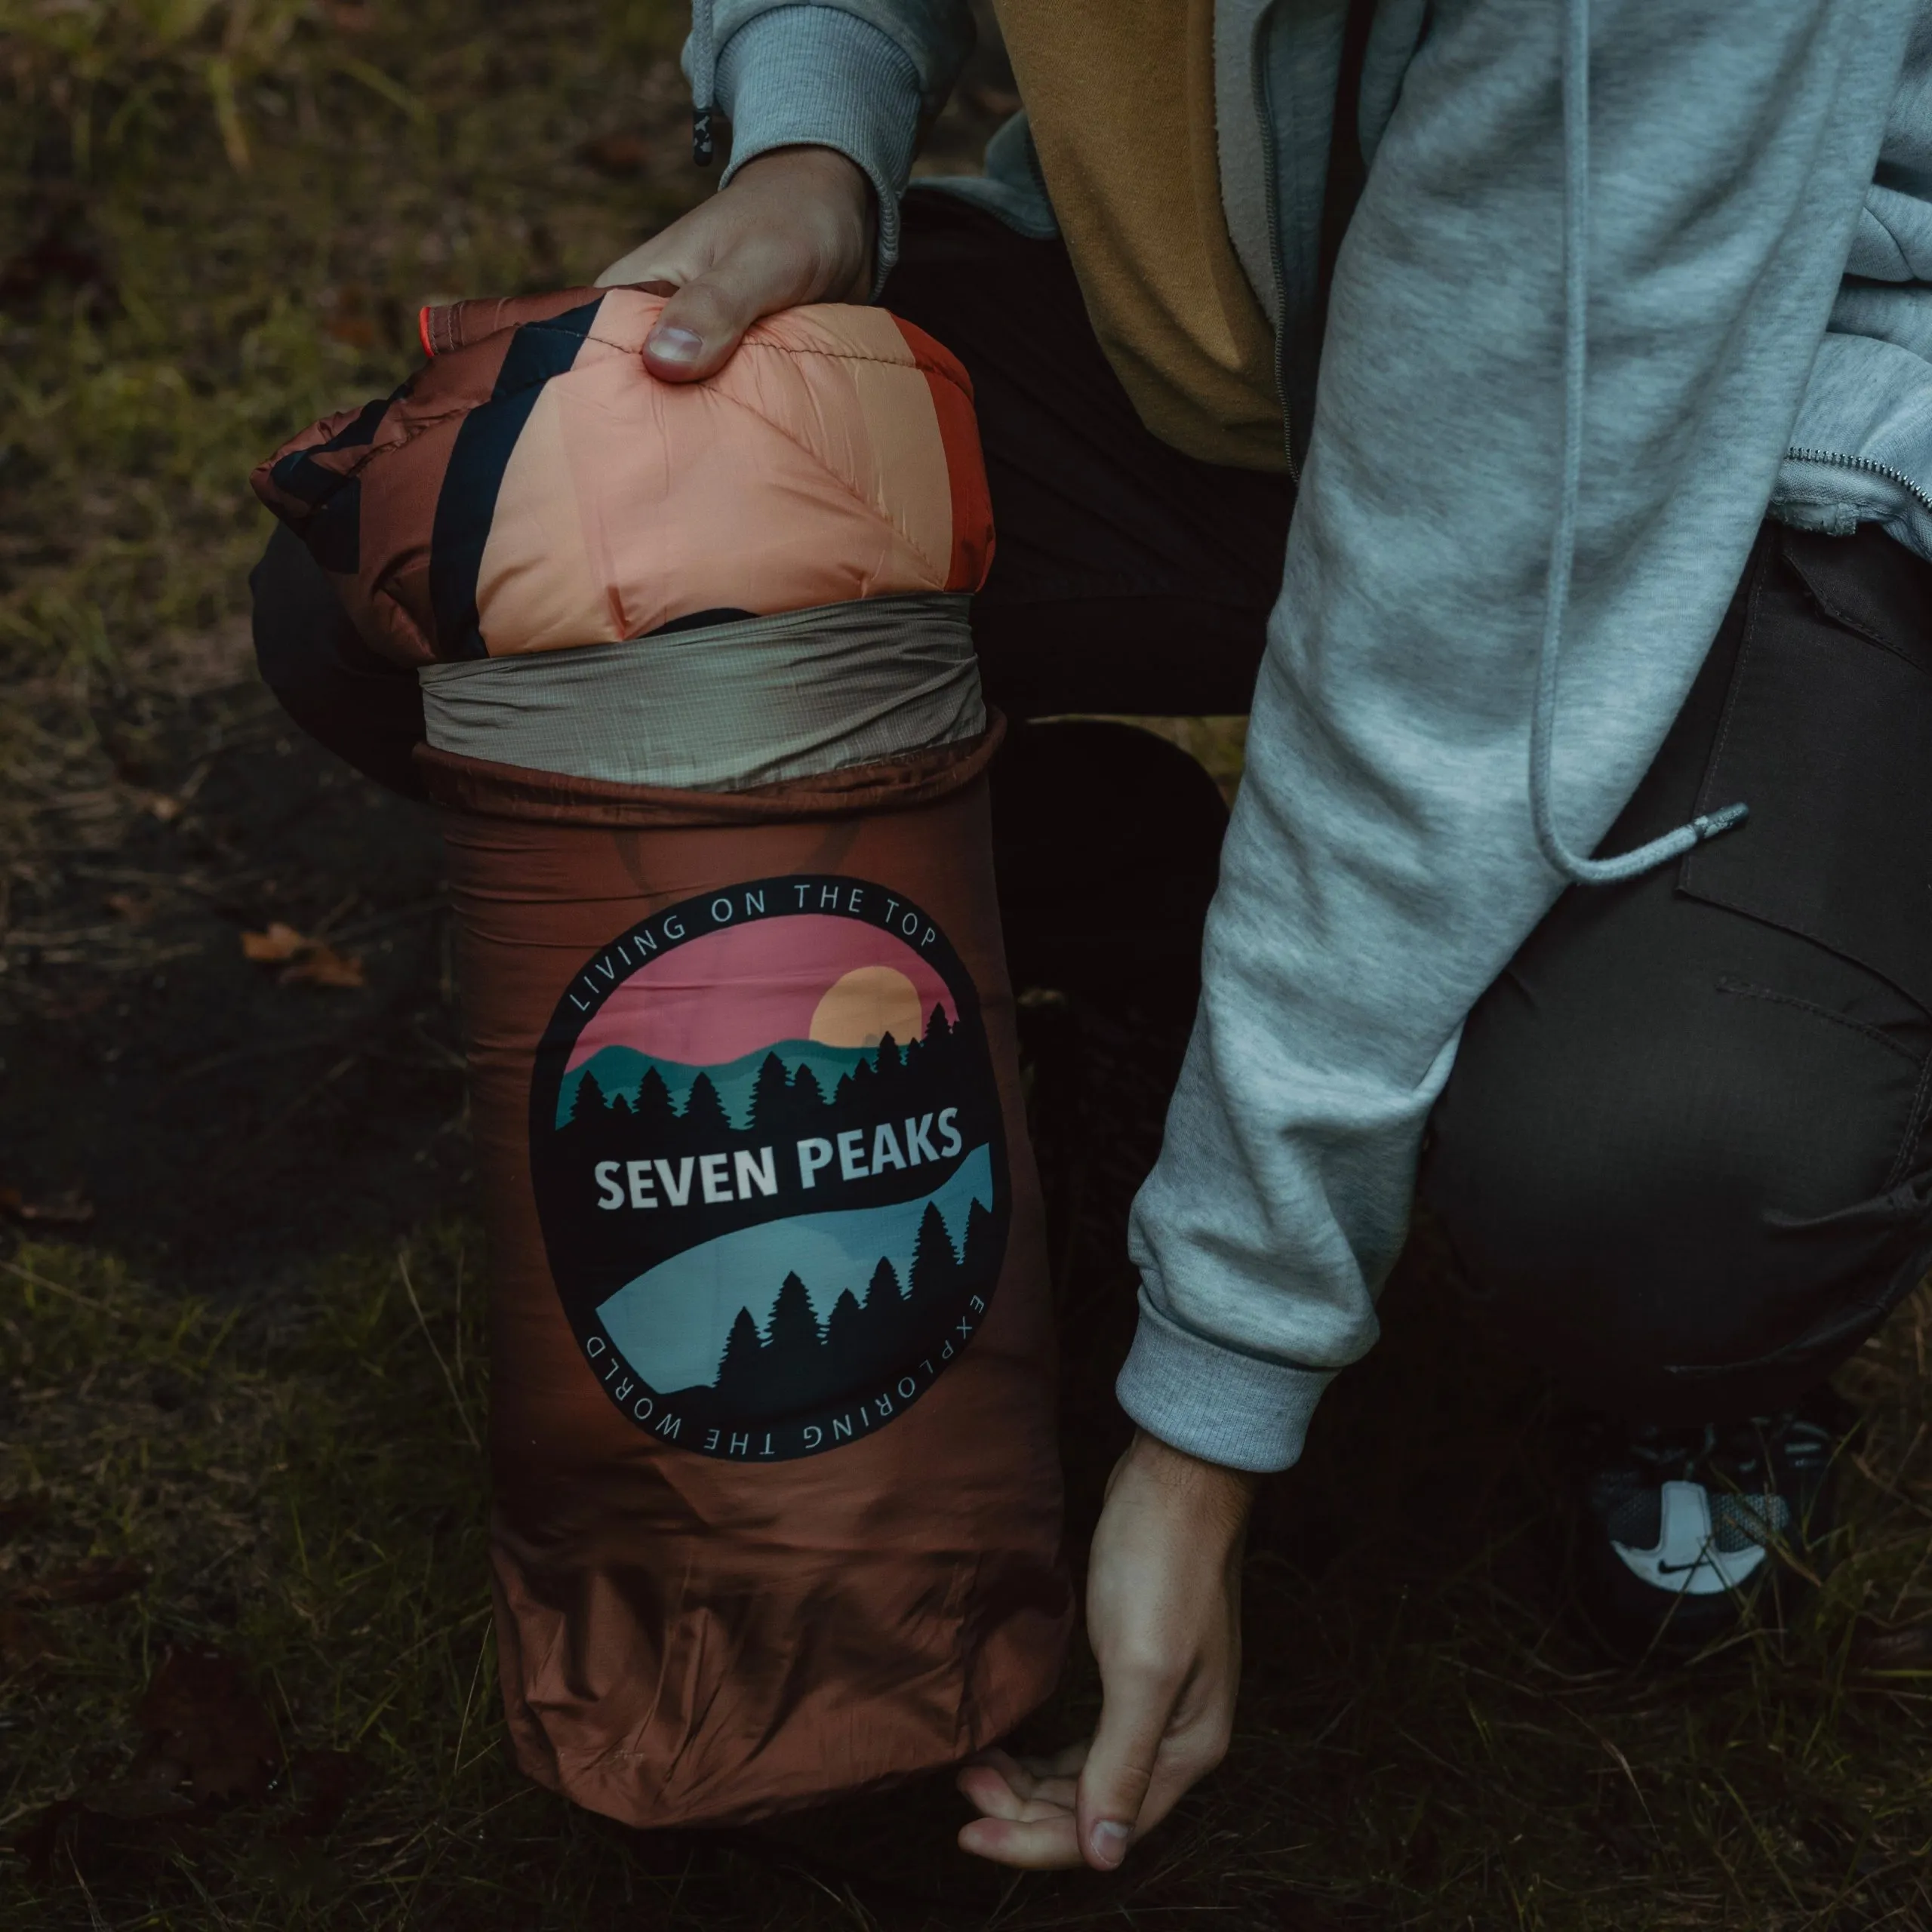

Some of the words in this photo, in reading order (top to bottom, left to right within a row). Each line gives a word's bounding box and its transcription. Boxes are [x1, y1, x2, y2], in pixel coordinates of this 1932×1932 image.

[570, 915, 685, 1011] LIVING
[712, 890, 765, 922] ON
[794, 884, 864, 912] THE
[884, 898, 937, 947] TOP
[594, 1146, 779, 1211] SEVEN
[796, 1106, 963, 1189] PEAKS
[586, 1336, 681, 1438] WORLD
[802, 1294, 985, 1449] EXPLORING
[703, 1428, 776, 1456] THE
